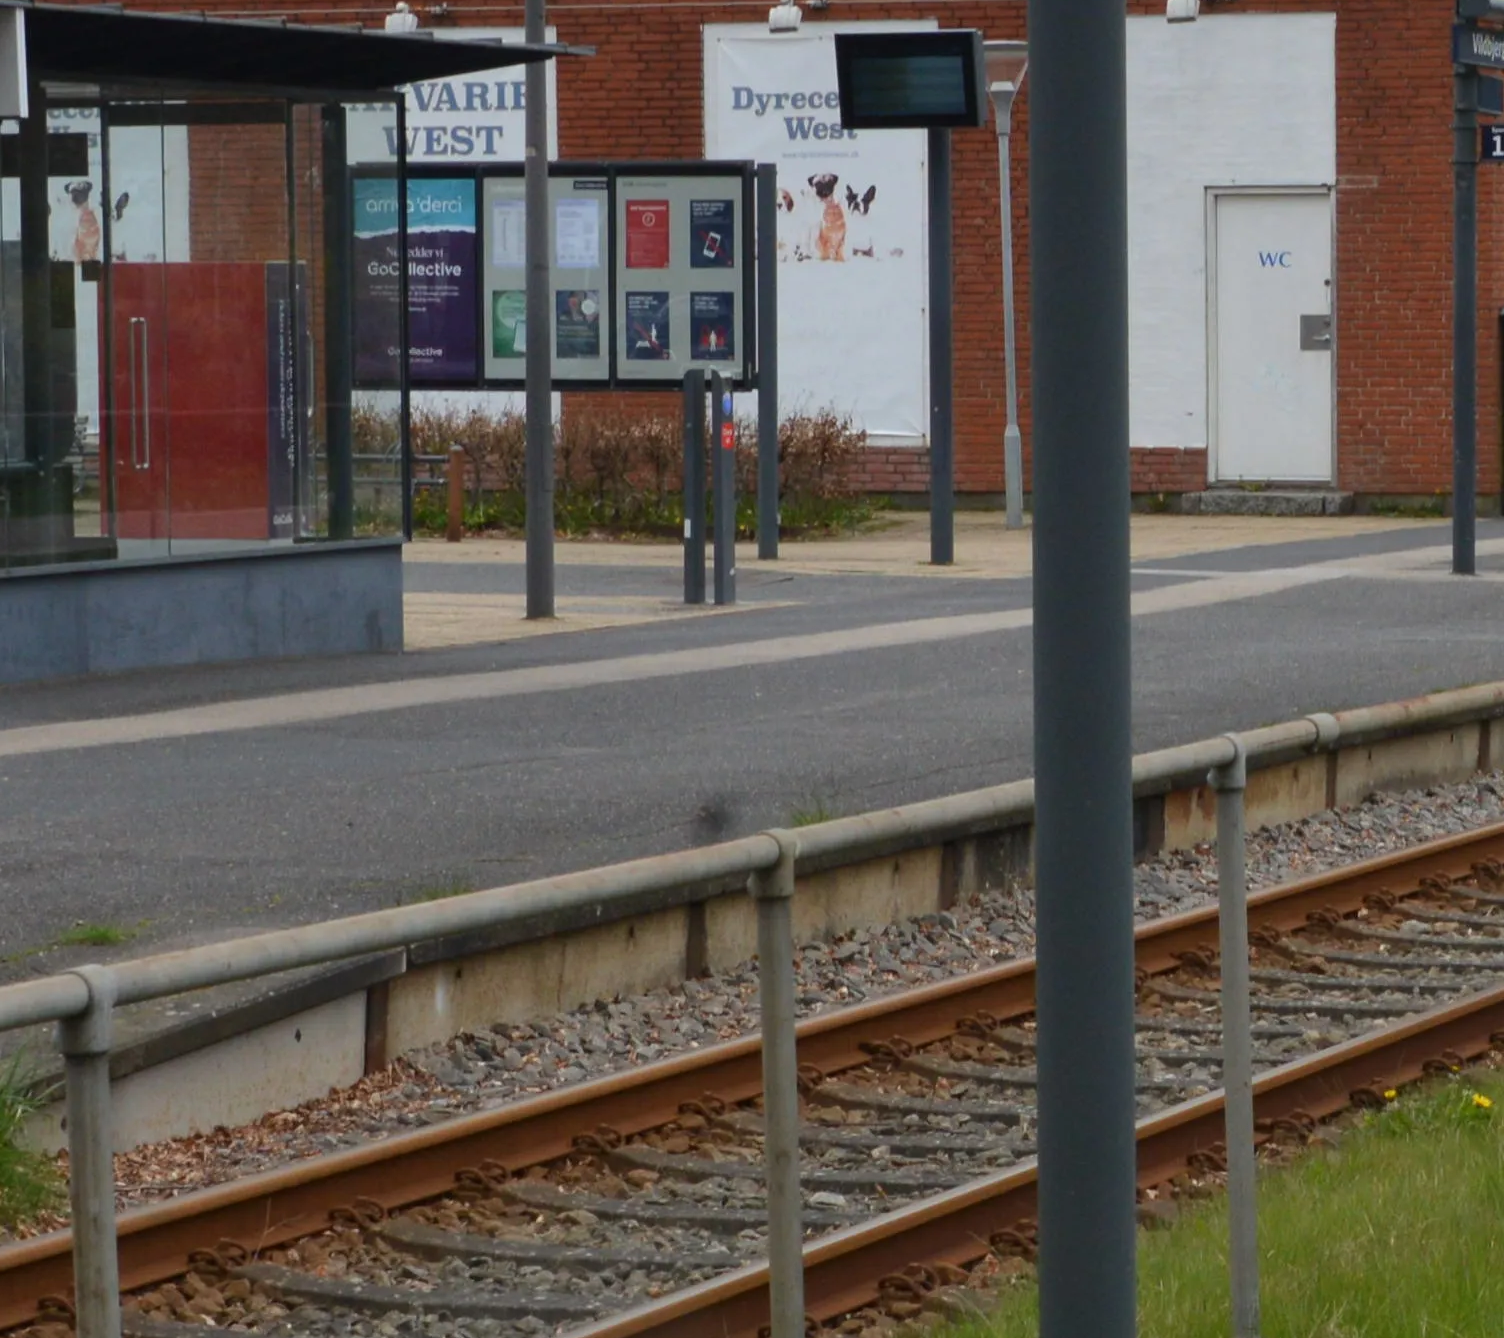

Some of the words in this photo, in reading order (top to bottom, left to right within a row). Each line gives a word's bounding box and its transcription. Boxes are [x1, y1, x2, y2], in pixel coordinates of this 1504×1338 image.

[783, 116, 858, 140] West
[382, 126, 504, 156] WEST
[1491, 135, 1504, 157] 1
[367, 261, 463, 277] GoCllective
[1258, 251, 1292, 268] WC
